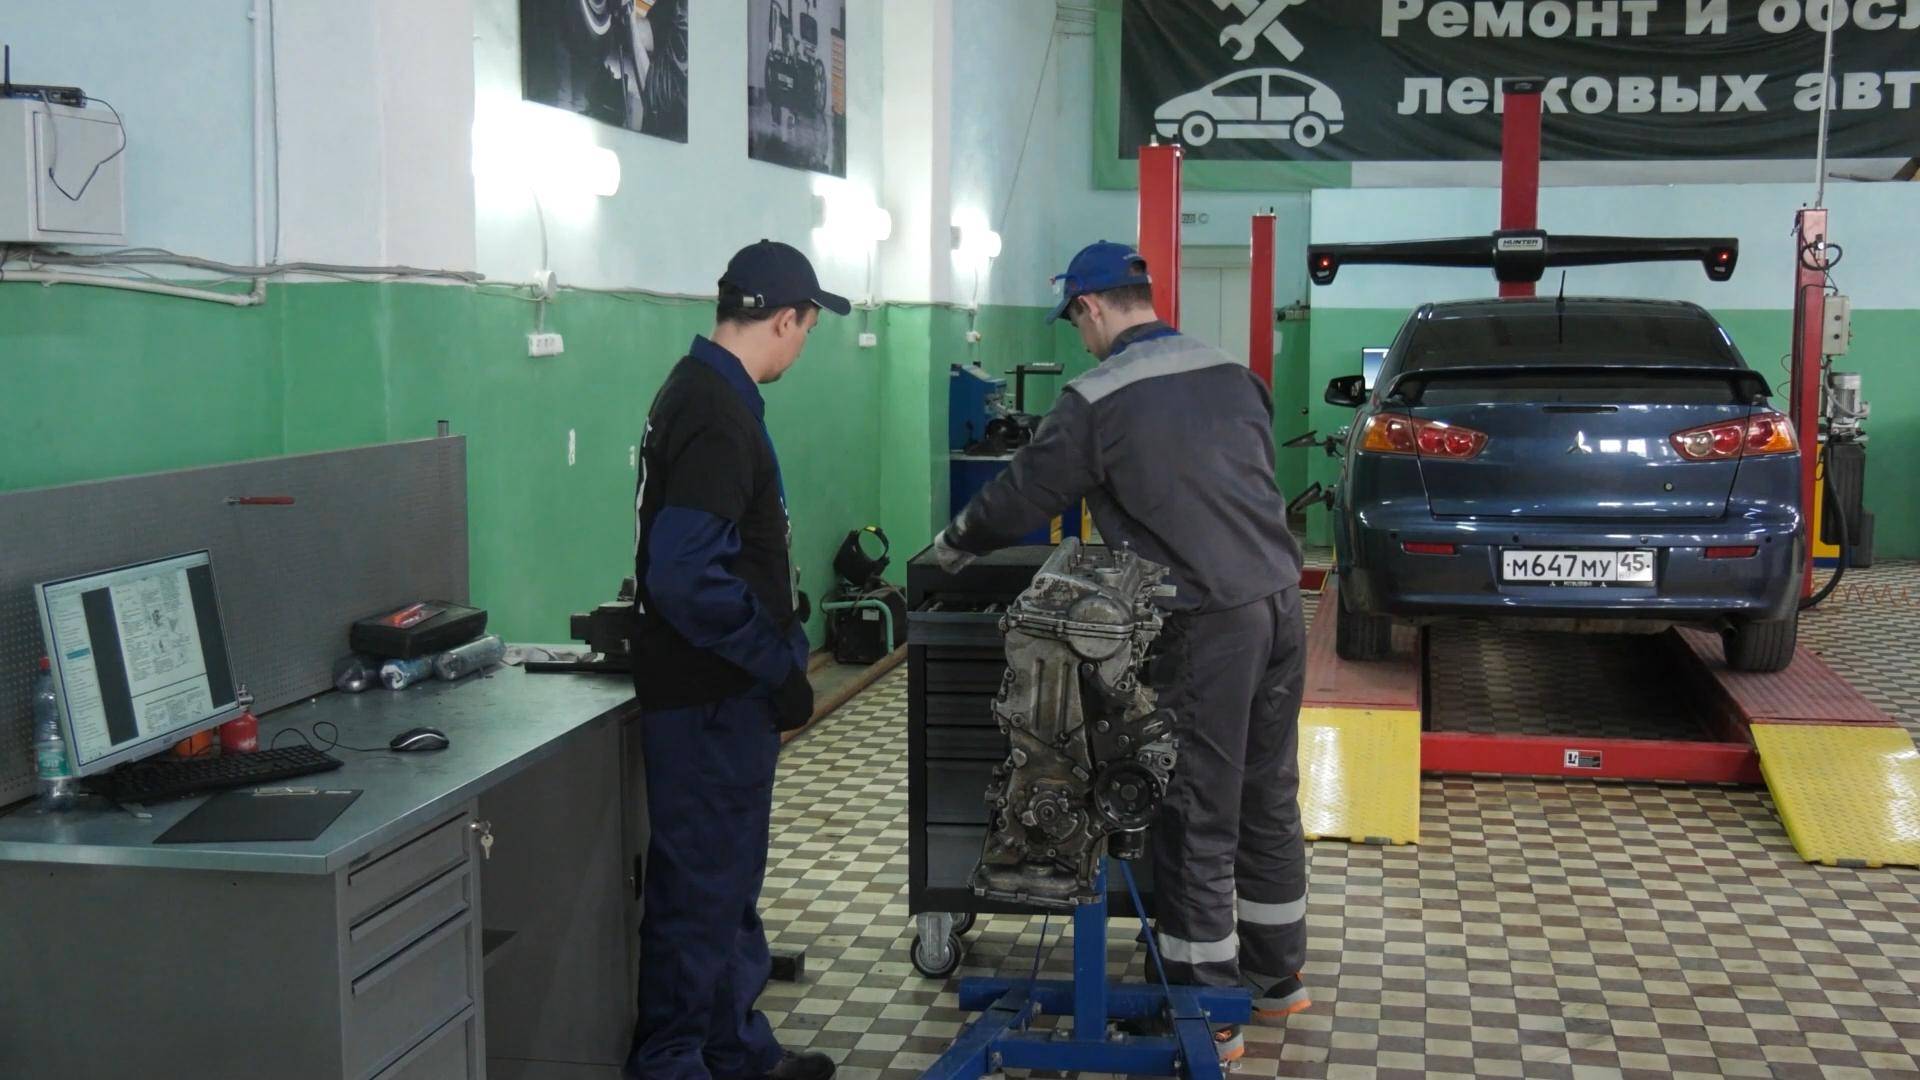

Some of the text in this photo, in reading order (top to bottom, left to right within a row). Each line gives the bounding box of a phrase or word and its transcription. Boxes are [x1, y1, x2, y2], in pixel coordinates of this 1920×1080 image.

[1381, 0, 1657, 38] Ремонт
[1685, 0, 1728, 35] и
[1397, 71, 1920, 115] лековых авт
[1512, 554, 1645, 577] М647МУ 45
